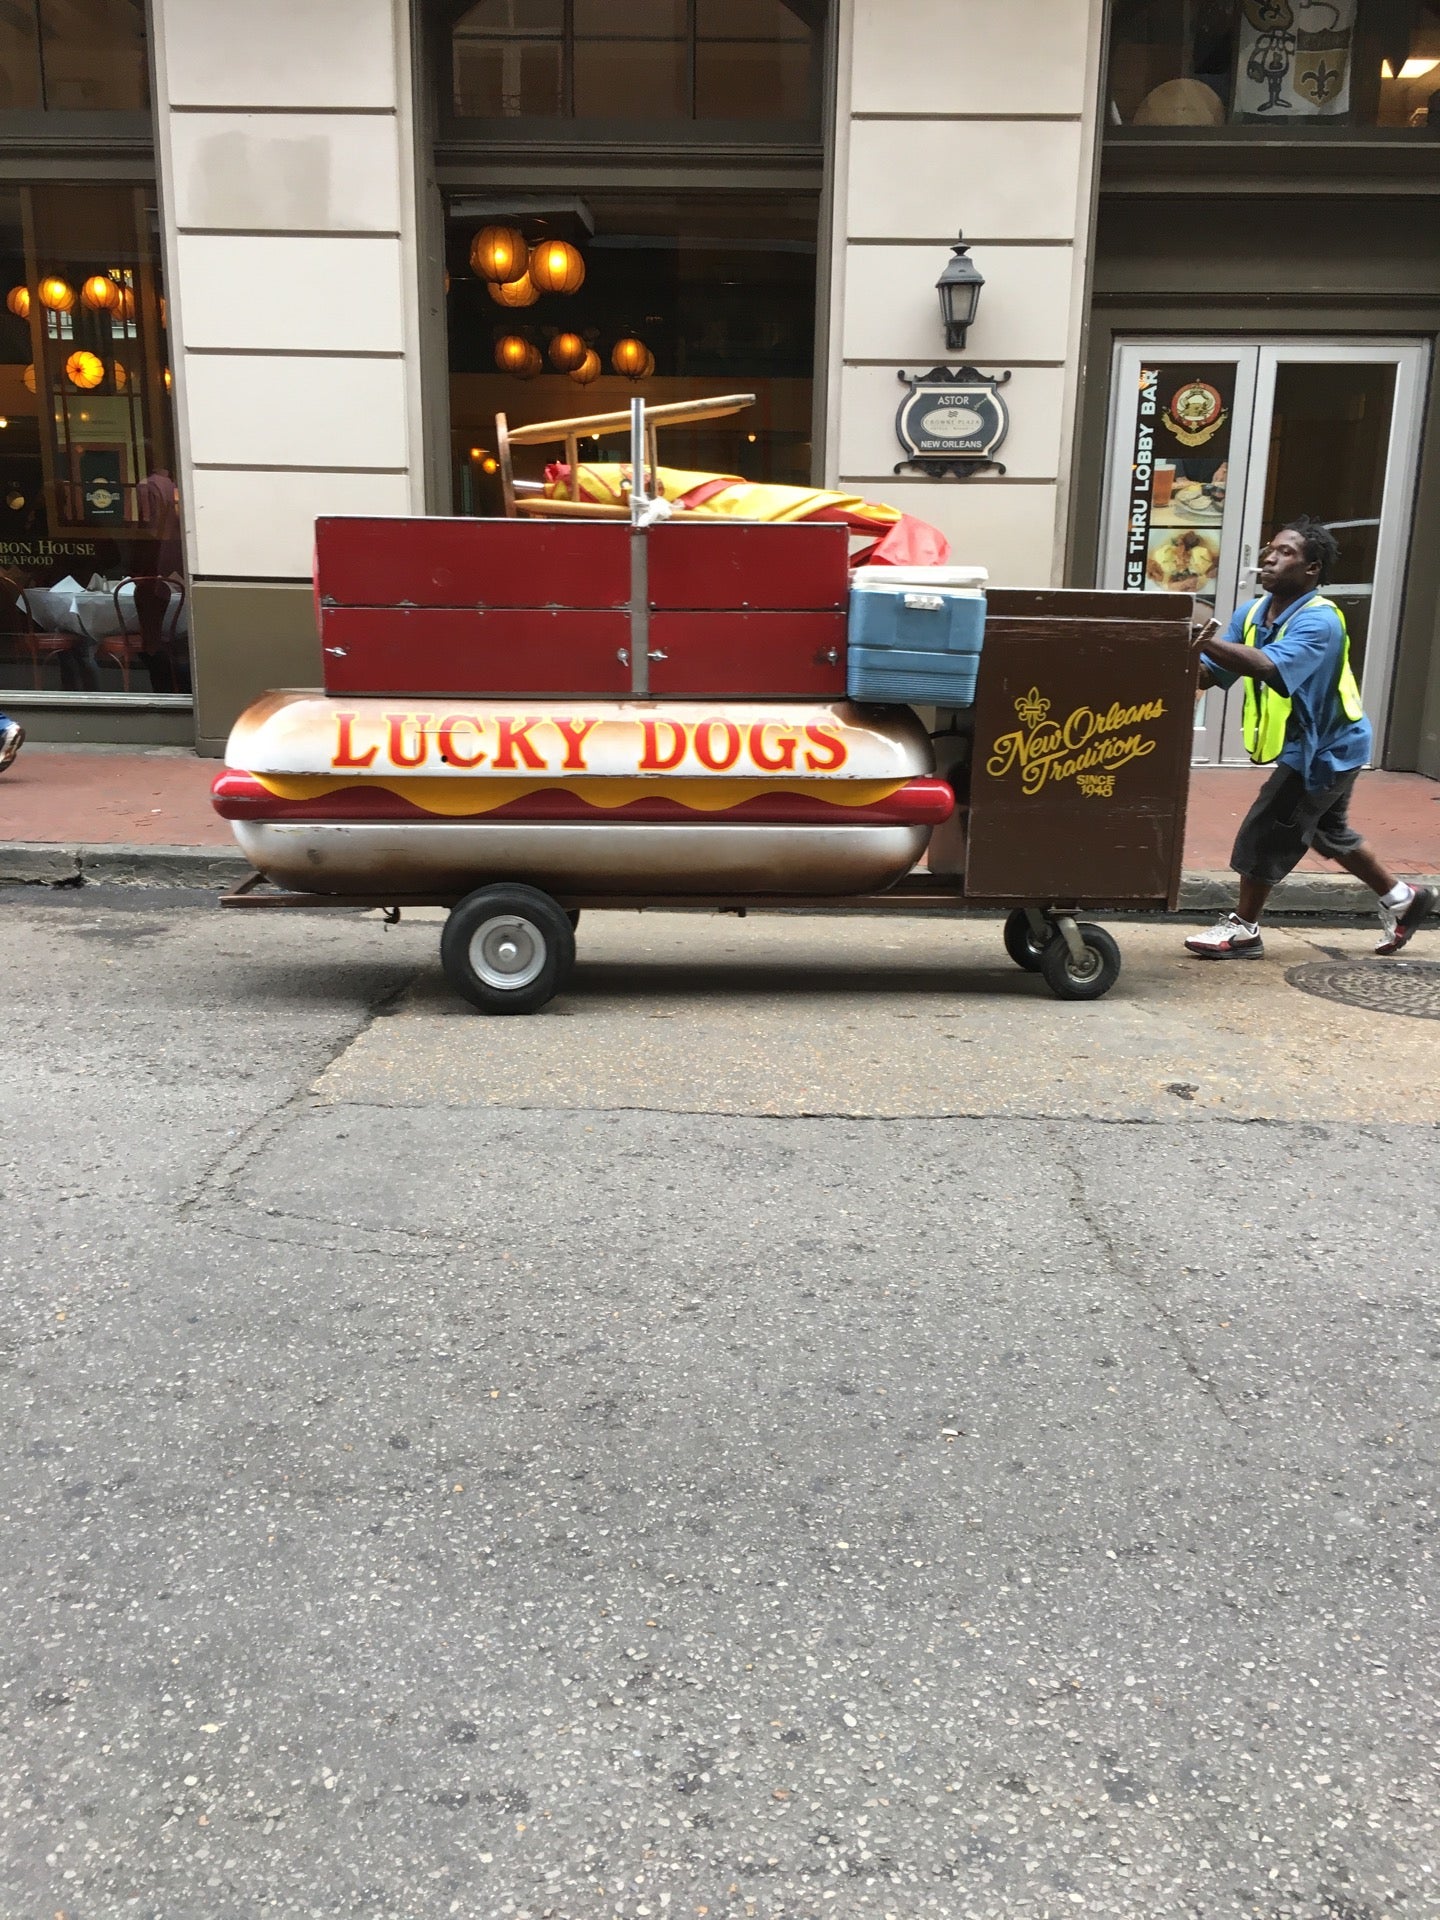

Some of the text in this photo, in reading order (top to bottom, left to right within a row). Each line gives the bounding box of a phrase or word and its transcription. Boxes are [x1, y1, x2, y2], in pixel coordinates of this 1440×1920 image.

[937, 395, 970, 406] ASTOR
[1141, 369, 1159, 416] BAR
[920, 440, 983, 449] NEW ORLEANS
[1135, 423, 1154, 491] LOBBY
[39, 540, 96, 556] HOUSE
[1129, 499, 1148, 554] THRU
[330, 711, 848, 772] LUCKY DOGS
[986, 698, 1169, 776] New Orleans
[1022, 734, 1156, 795] Tradition
[1076, 774, 1116, 786] SINCE
[1081, 784, 1113, 799] 1948
